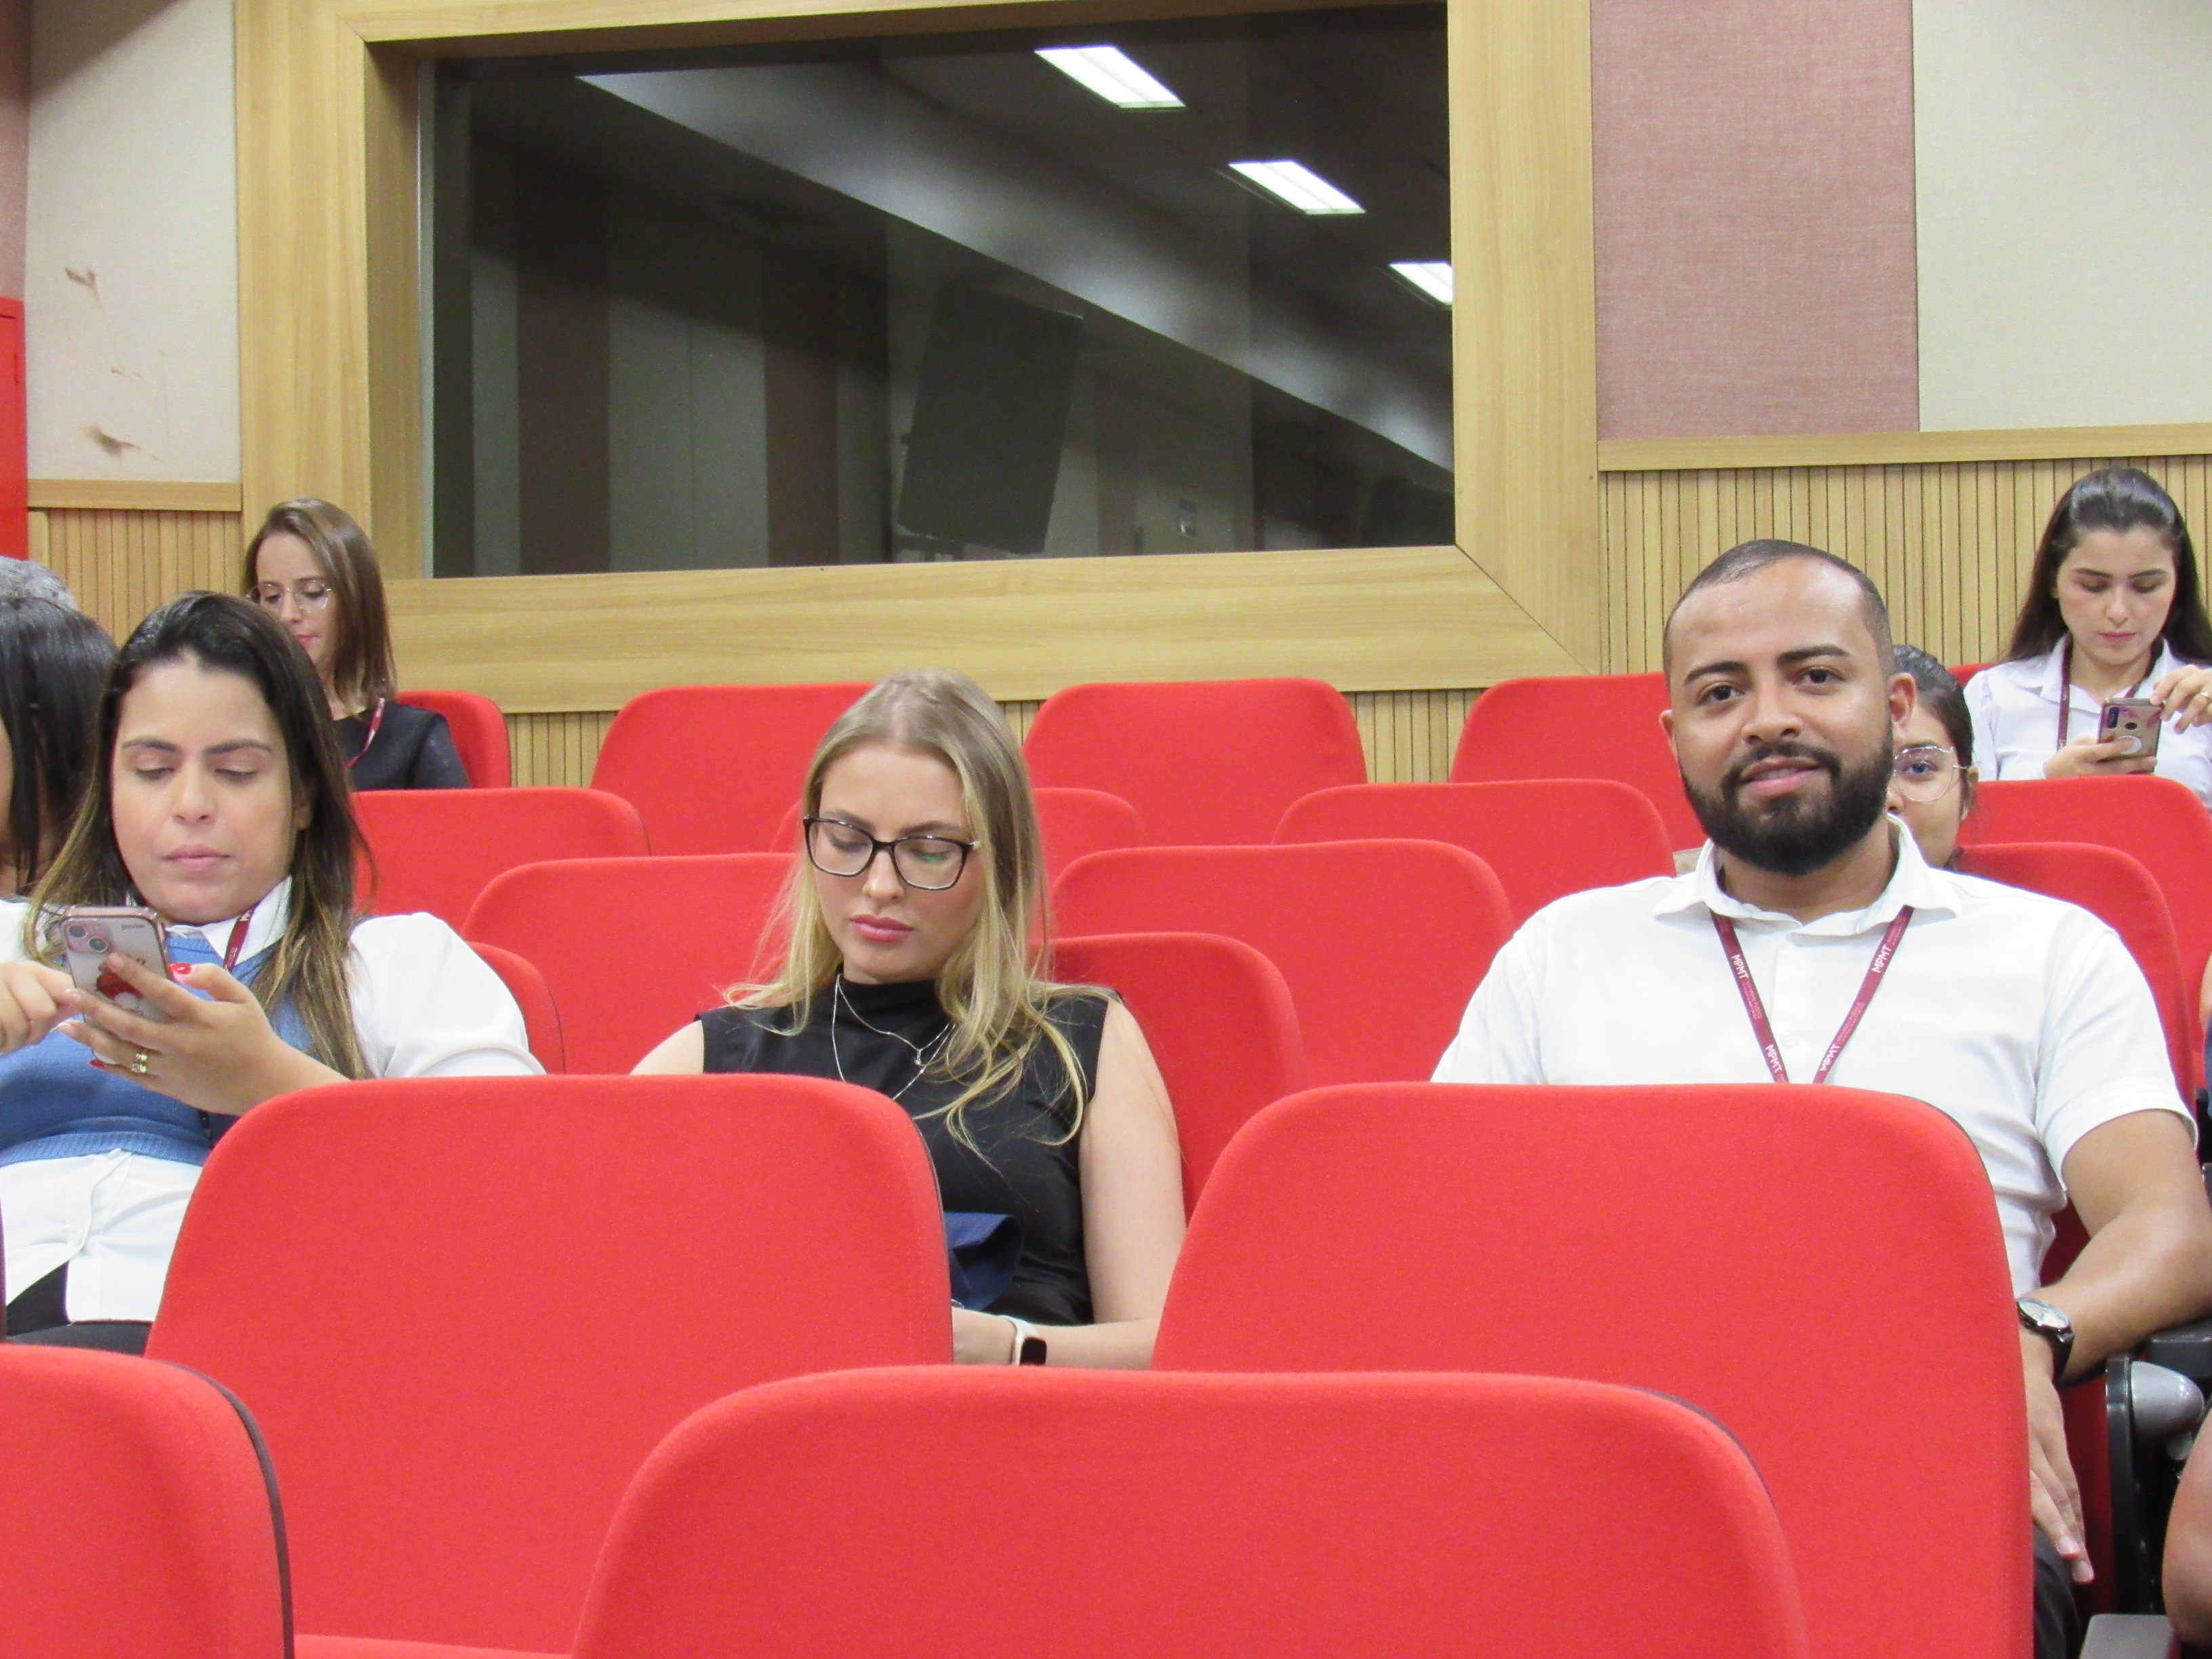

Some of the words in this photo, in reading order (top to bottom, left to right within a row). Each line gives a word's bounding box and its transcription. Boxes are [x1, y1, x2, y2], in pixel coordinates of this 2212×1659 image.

[1730, 954, 1749, 980] MPMT
[1872, 943, 1892, 973] MPMT
[1765, 1044, 1783, 1073] MPMT
[1820, 1044, 1841, 1071] MPMT
